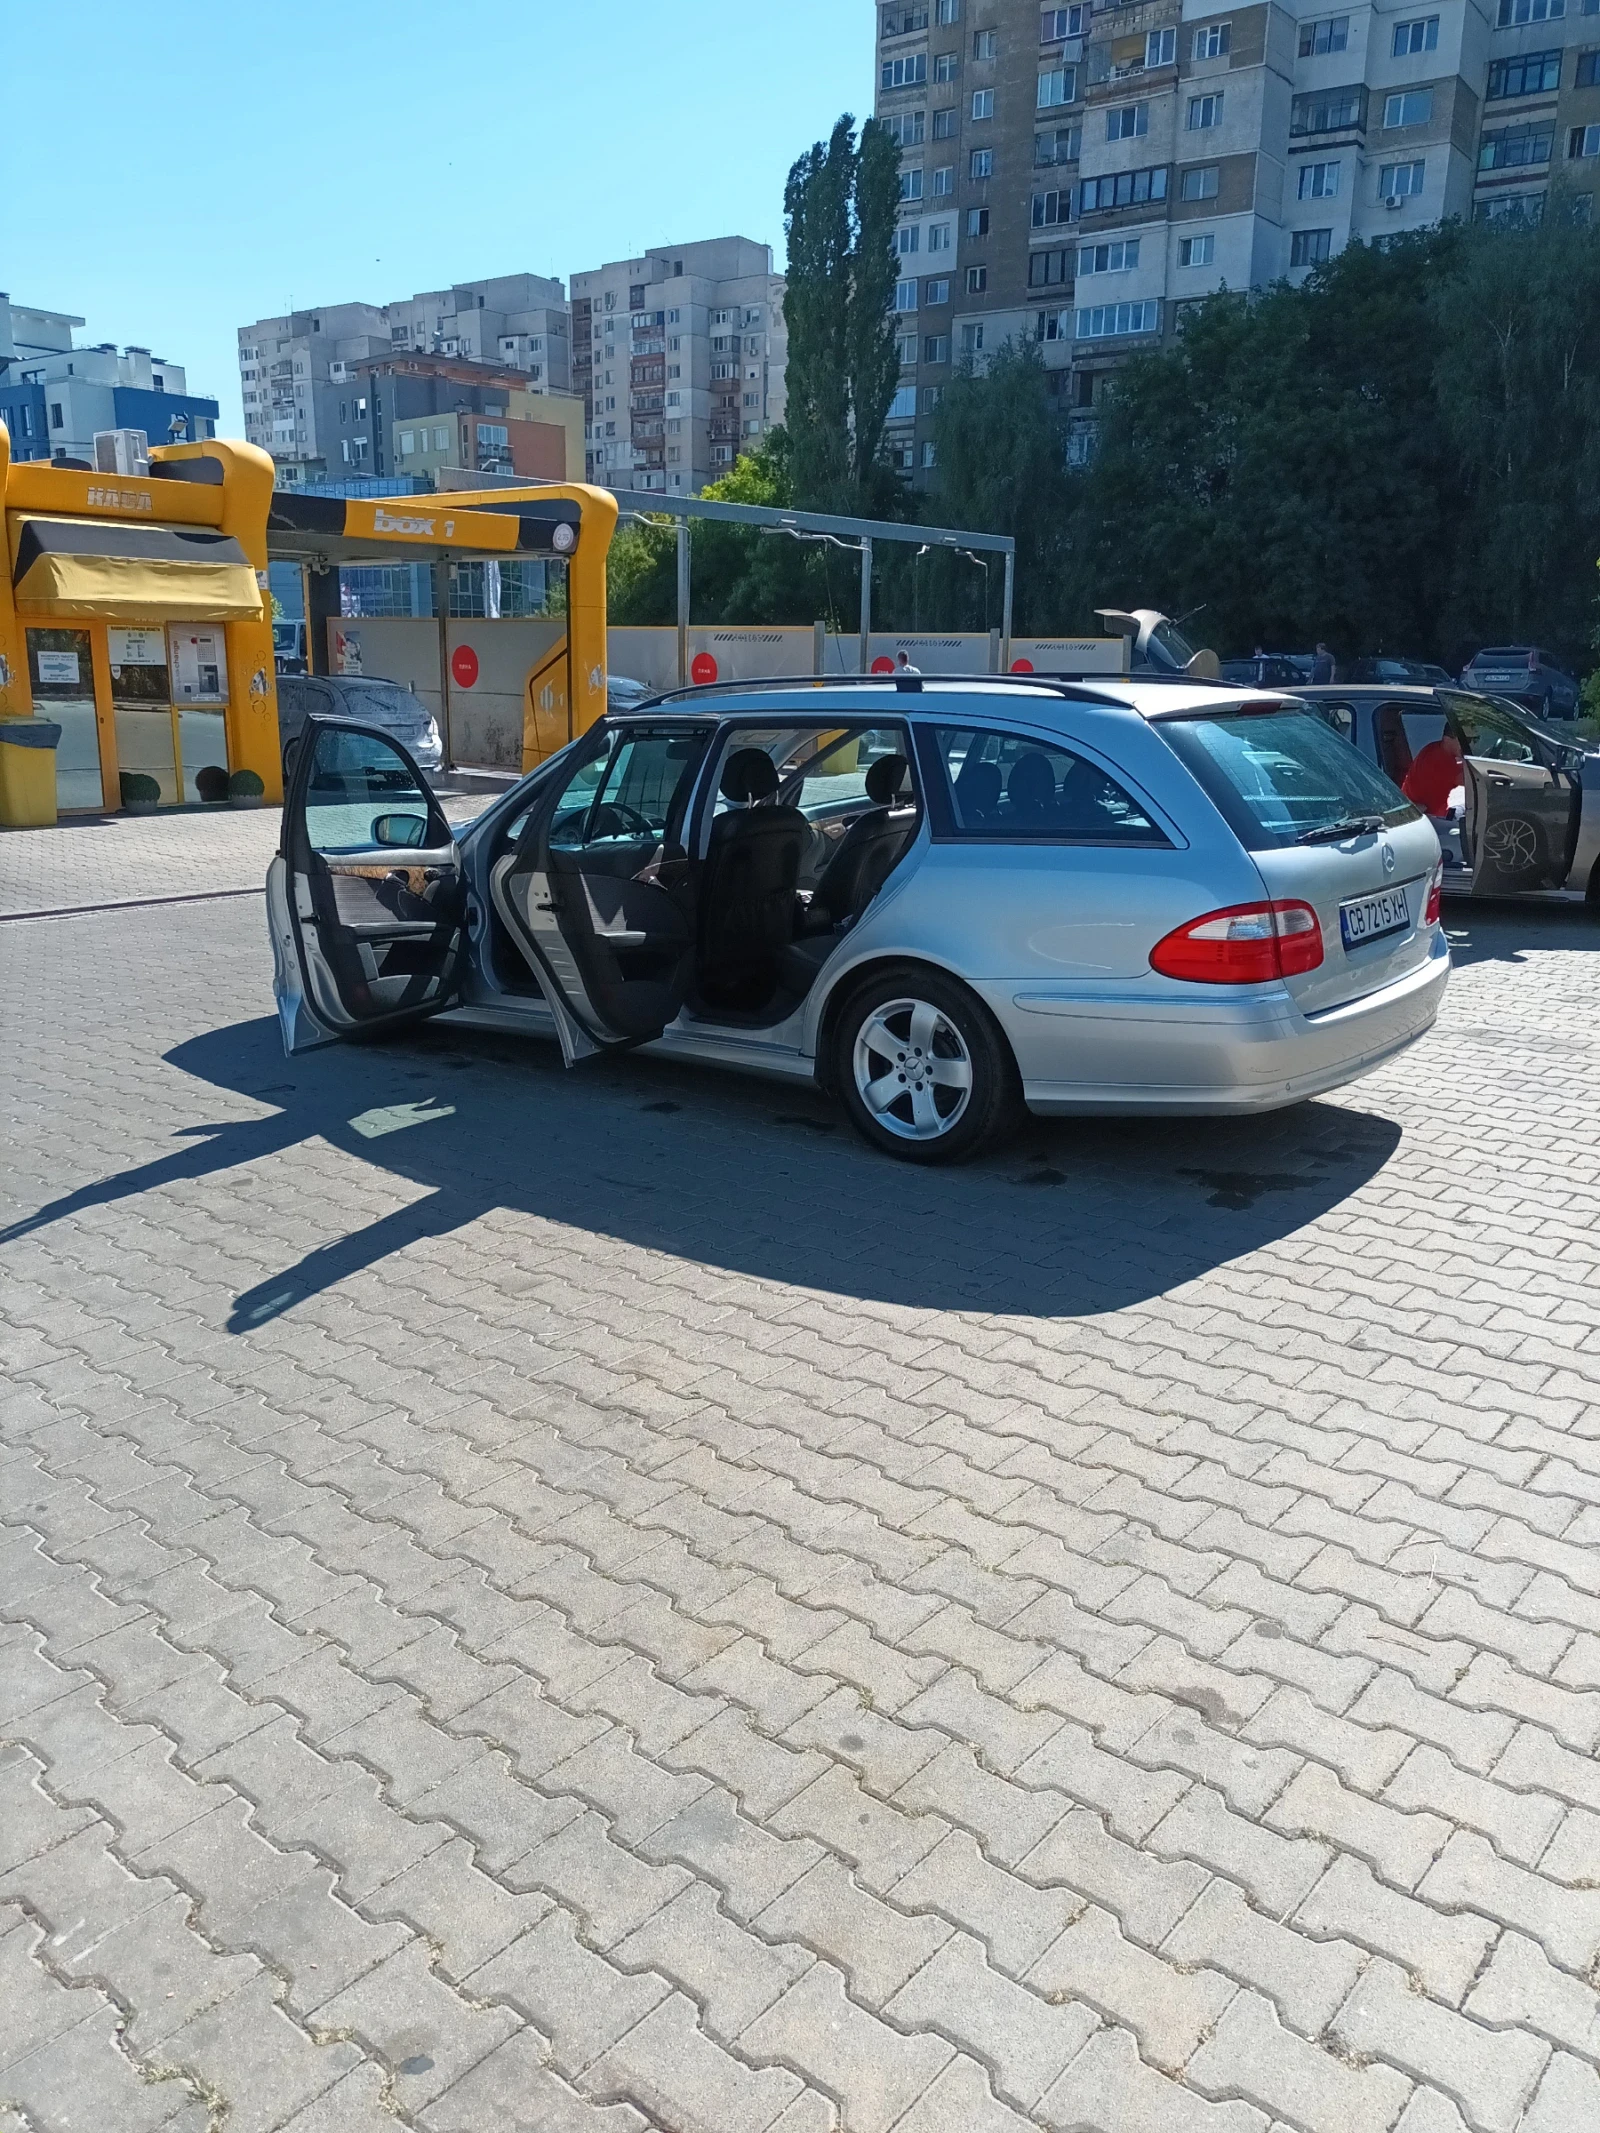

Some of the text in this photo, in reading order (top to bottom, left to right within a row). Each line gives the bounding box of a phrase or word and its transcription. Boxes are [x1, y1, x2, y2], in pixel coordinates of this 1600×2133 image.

[87, 486, 153, 511] КАСА
[374, 508, 455, 538] box 1
[1349, 893, 1407, 936] CB 7215 XH
